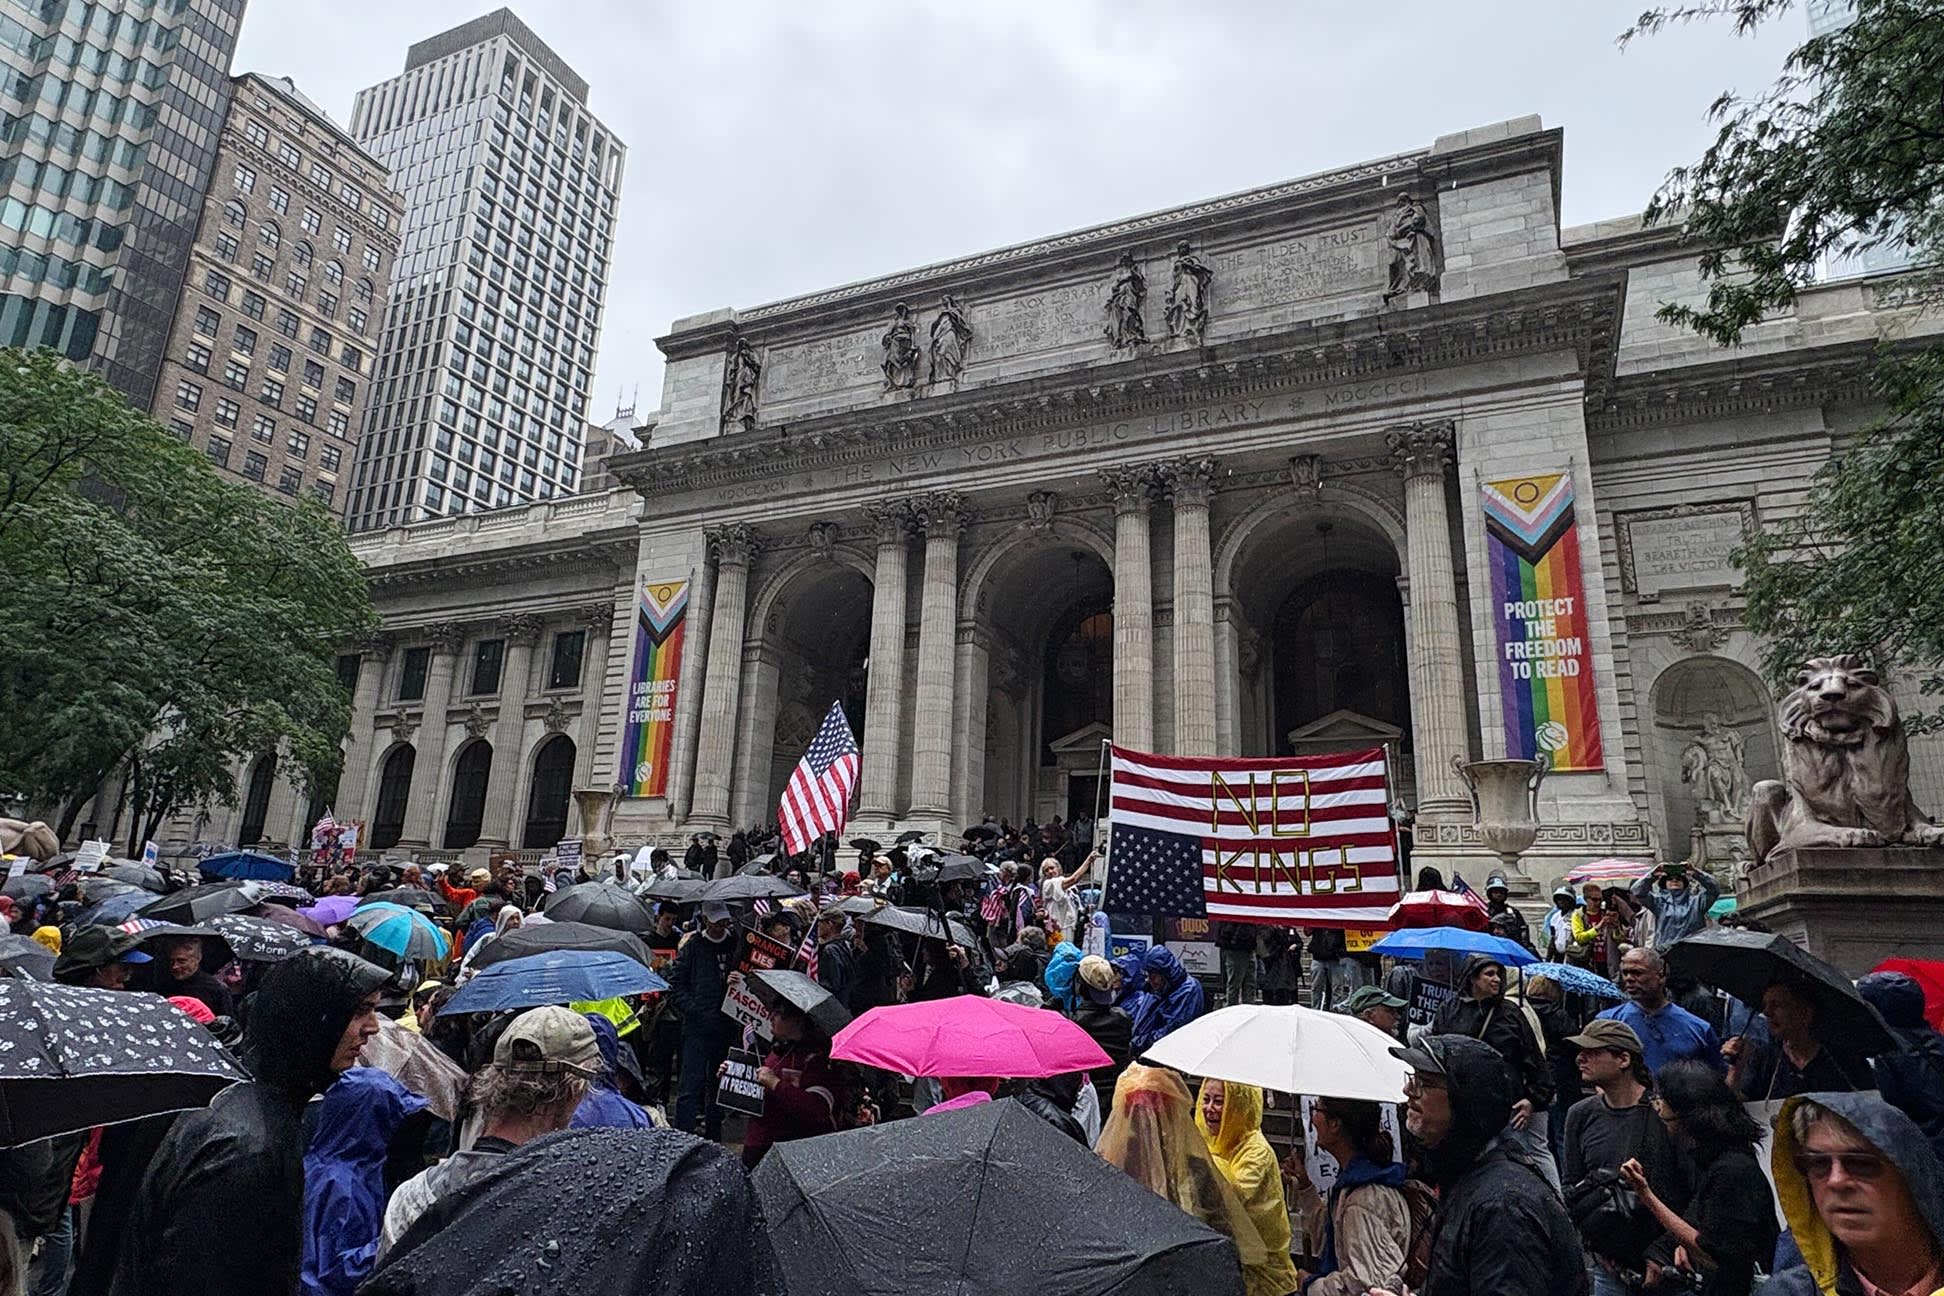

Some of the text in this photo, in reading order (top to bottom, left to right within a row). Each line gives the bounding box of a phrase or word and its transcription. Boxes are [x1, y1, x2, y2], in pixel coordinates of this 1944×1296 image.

[1217, 227, 1368, 269] THE TILDEN TRUST
[831, 463, 873, 484] THE
[888, 453, 944, 476] NEW
[963, 440, 1023, 464] YORK
[1043, 423, 1129, 450] PUBLIC
[1153, 401, 1265, 435] LIBRARY
[1504, 597, 1575, 620] PROTECT
[1525, 620, 1557, 638] THE
[1505, 637, 1582, 660] FREEDOM
[1510, 659, 1580, 680] TO READ
[633, 680, 676, 695] LIBRARIES
[635, 694, 670, 709] ARE FOR
[629, 708, 673, 724] EVERYONE
[1211, 770, 1310, 837] NO
[1215, 841, 1363, 896] KINGS
[253, 942, 288, 956] Storm
[746, 932, 789, 960] ORANGE
[751, 949, 776, 969] LIES
[1409, 1006, 1424, 1021] OF
[1417, 994, 1440, 1012] THE
[730, 1075, 766, 1101] PRESIDENT
